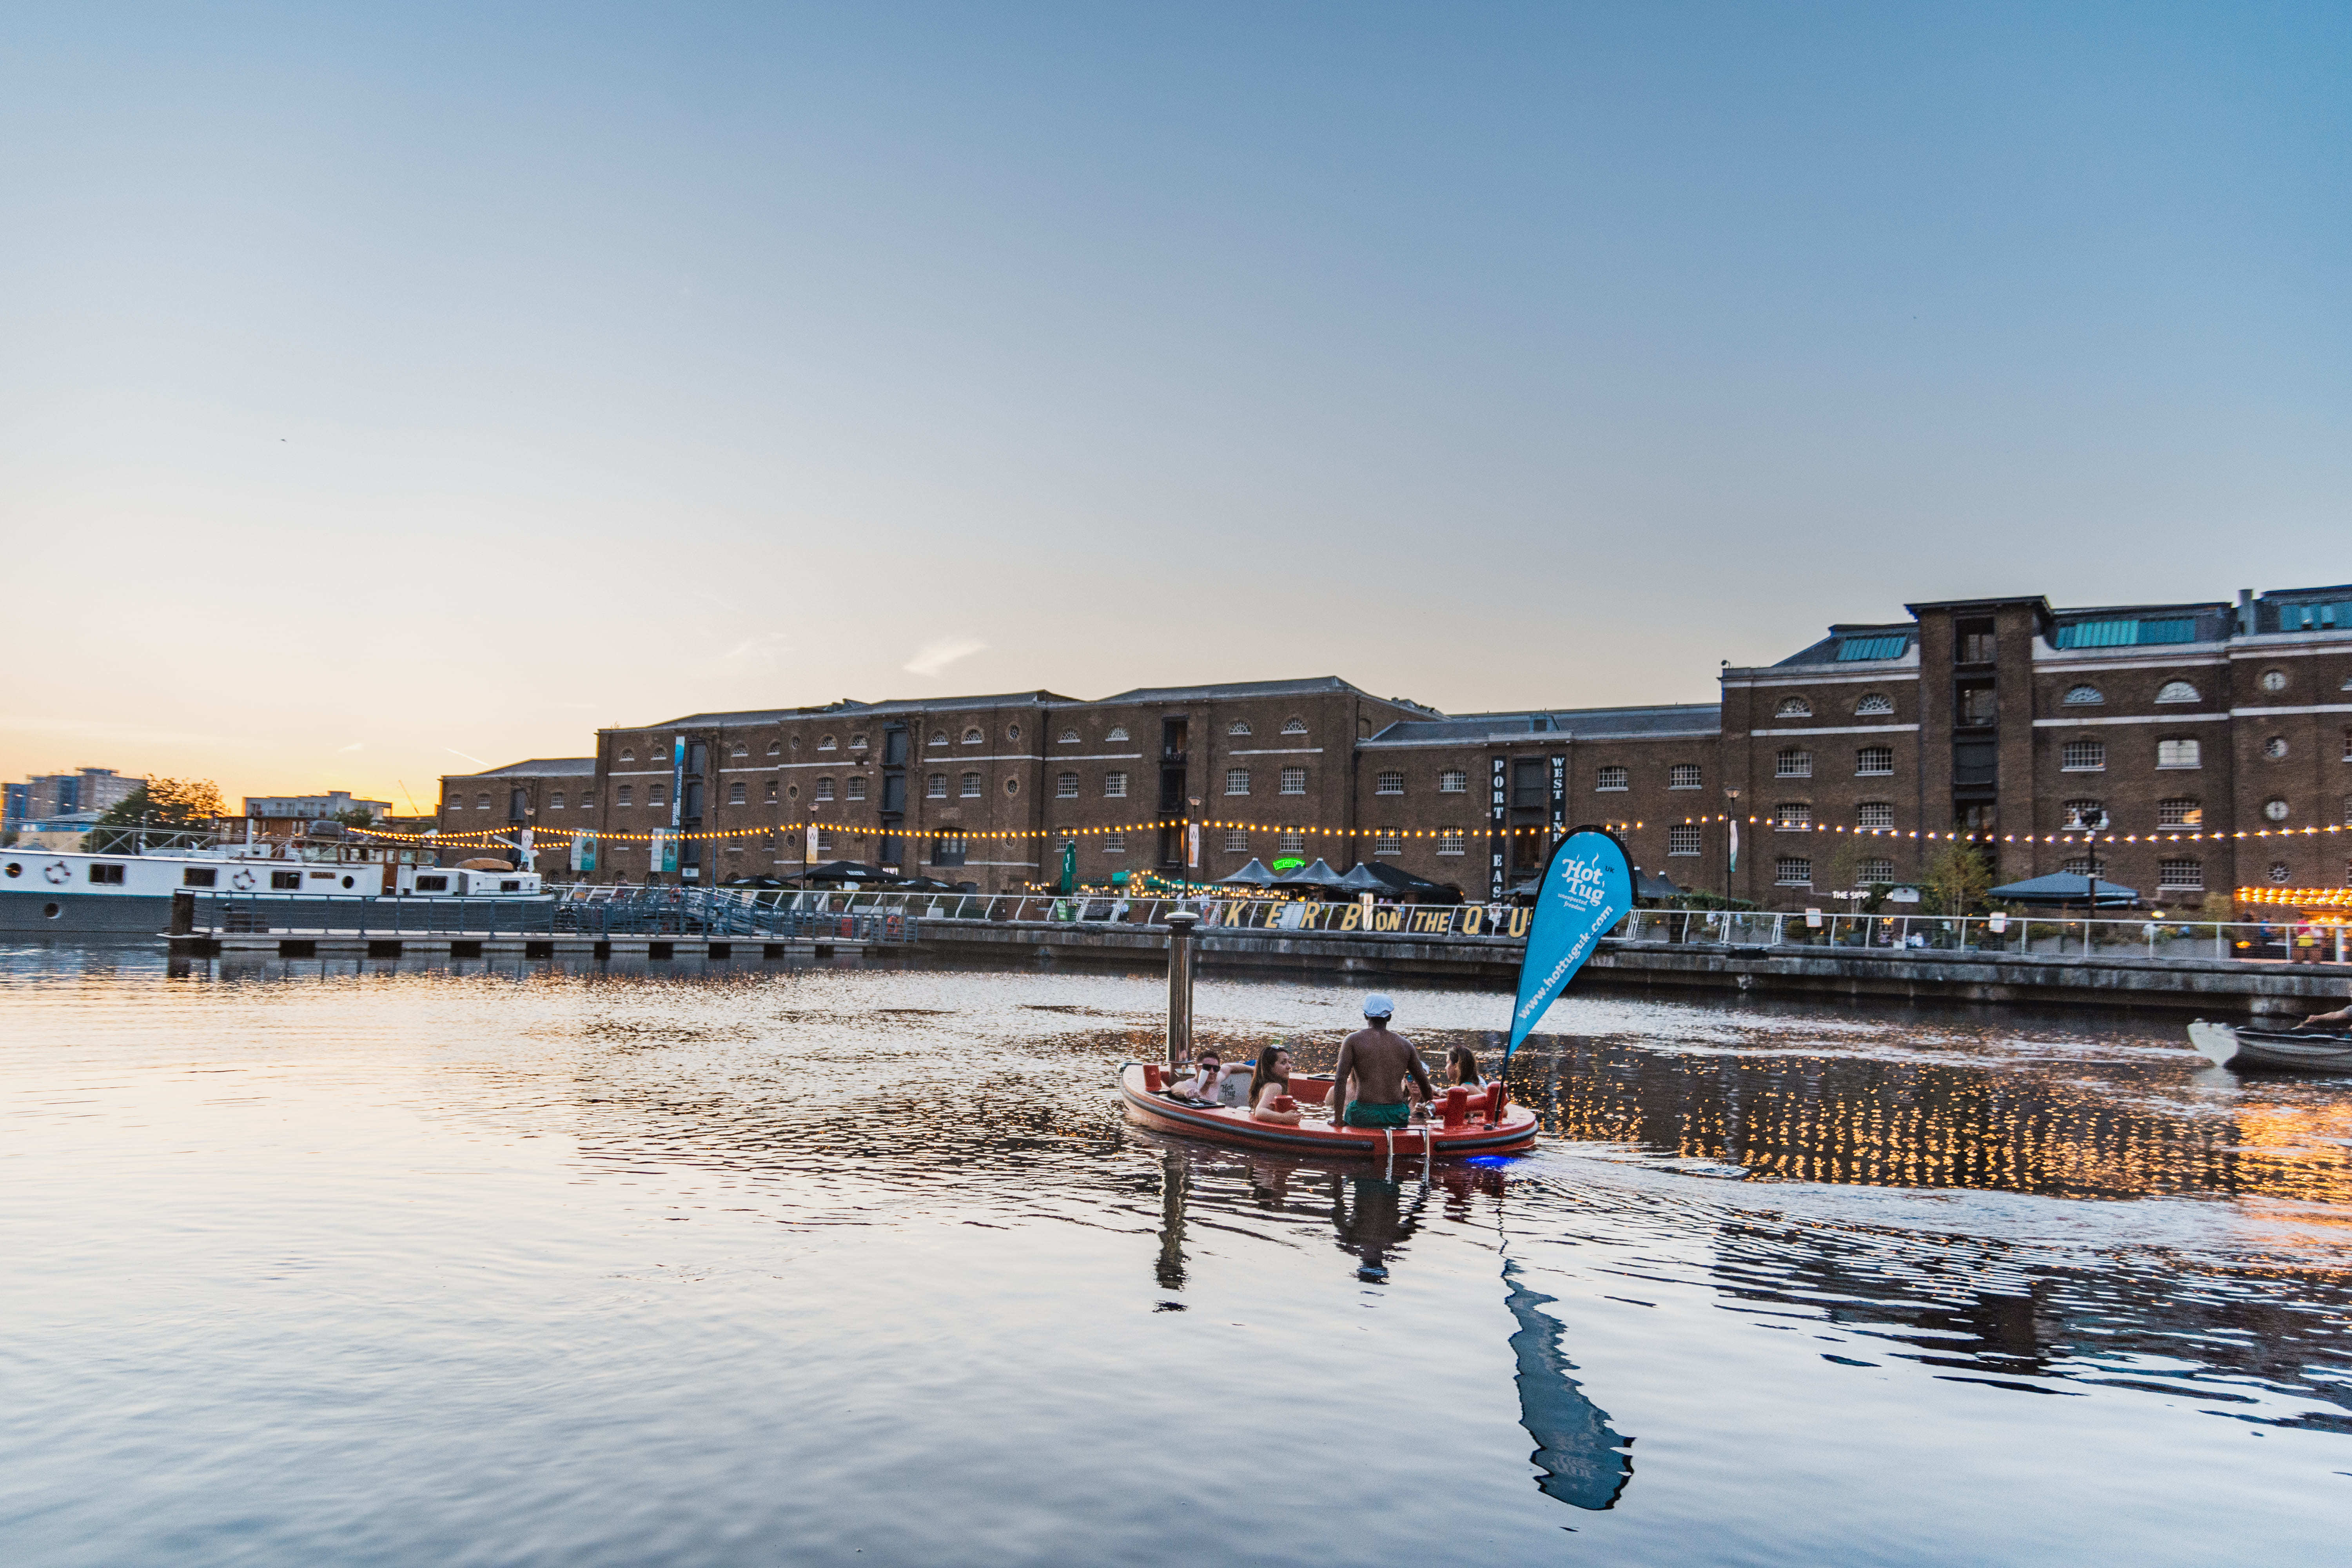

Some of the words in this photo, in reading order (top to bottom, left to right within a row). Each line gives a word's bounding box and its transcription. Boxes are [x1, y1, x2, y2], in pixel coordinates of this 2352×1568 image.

[1494, 760, 1504, 819] PORT
[1552, 758, 1565, 799] WEST
[1190, 831, 1197, 839] W
[1553, 811, 1563, 842] IND
[1492, 855, 1503, 898] EAS
[1562, 858, 1603, 885] Hot
[1558, 893, 1588, 905] unexpected
[1566, 877, 1605, 907] Tug
[1832, 891, 1848, 899] THE
[1563, 901, 1586, 912] freedom
[1375, 912, 1402, 931] ON
[1414, 912, 1450, 932] THE
[1518, 906, 1613, 1019] www.hottuguk.com
